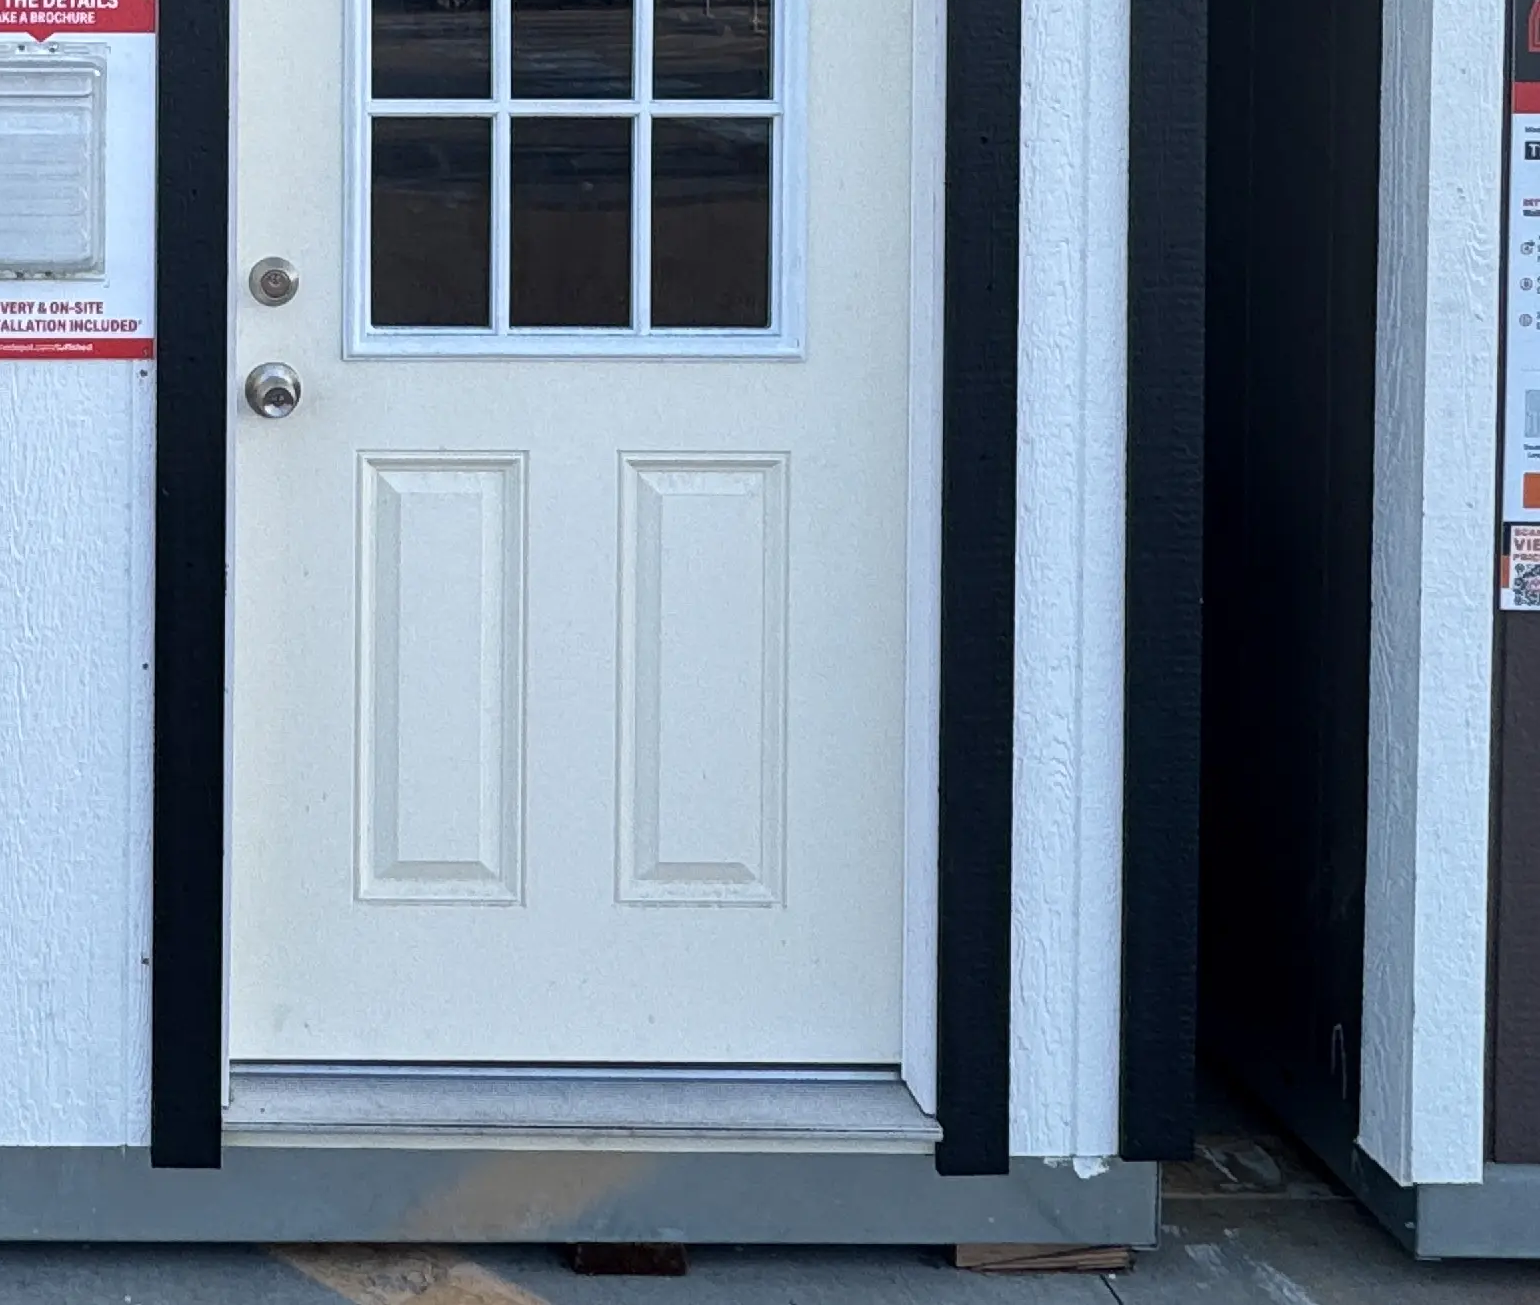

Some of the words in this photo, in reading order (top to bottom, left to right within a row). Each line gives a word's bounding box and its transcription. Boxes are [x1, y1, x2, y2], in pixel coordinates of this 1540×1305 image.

[19, 12, 28, 24] A
[30, 12, 95, 25] BROCHURE
[37, 302, 47, 314] &
[50, 302, 104, 314] ON-SITE
[1514, 538, 1540, 551] VIE
